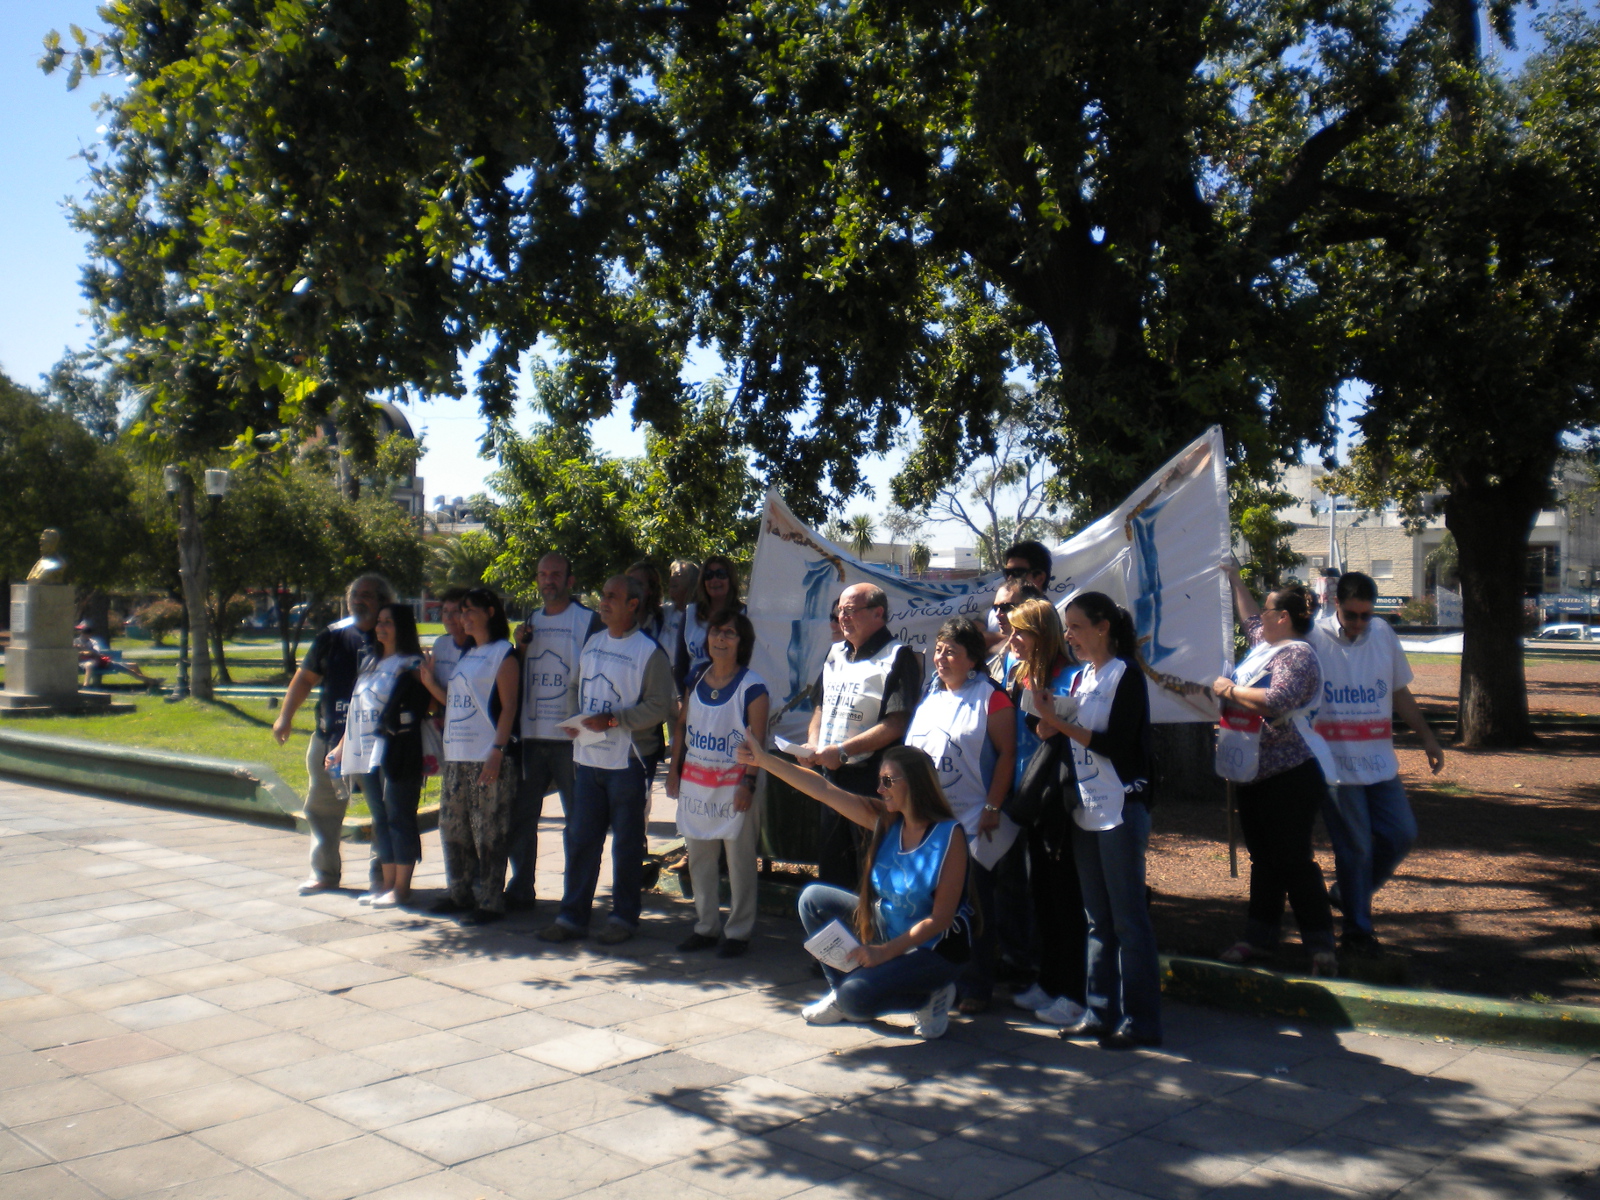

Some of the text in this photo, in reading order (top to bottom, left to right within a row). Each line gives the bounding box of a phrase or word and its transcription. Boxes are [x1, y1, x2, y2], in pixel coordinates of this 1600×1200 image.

[958, 596, 981, 615] de
[532, 673, 567, 688] F.E.B.
[1324, 681, 1376, 704] Suteba
